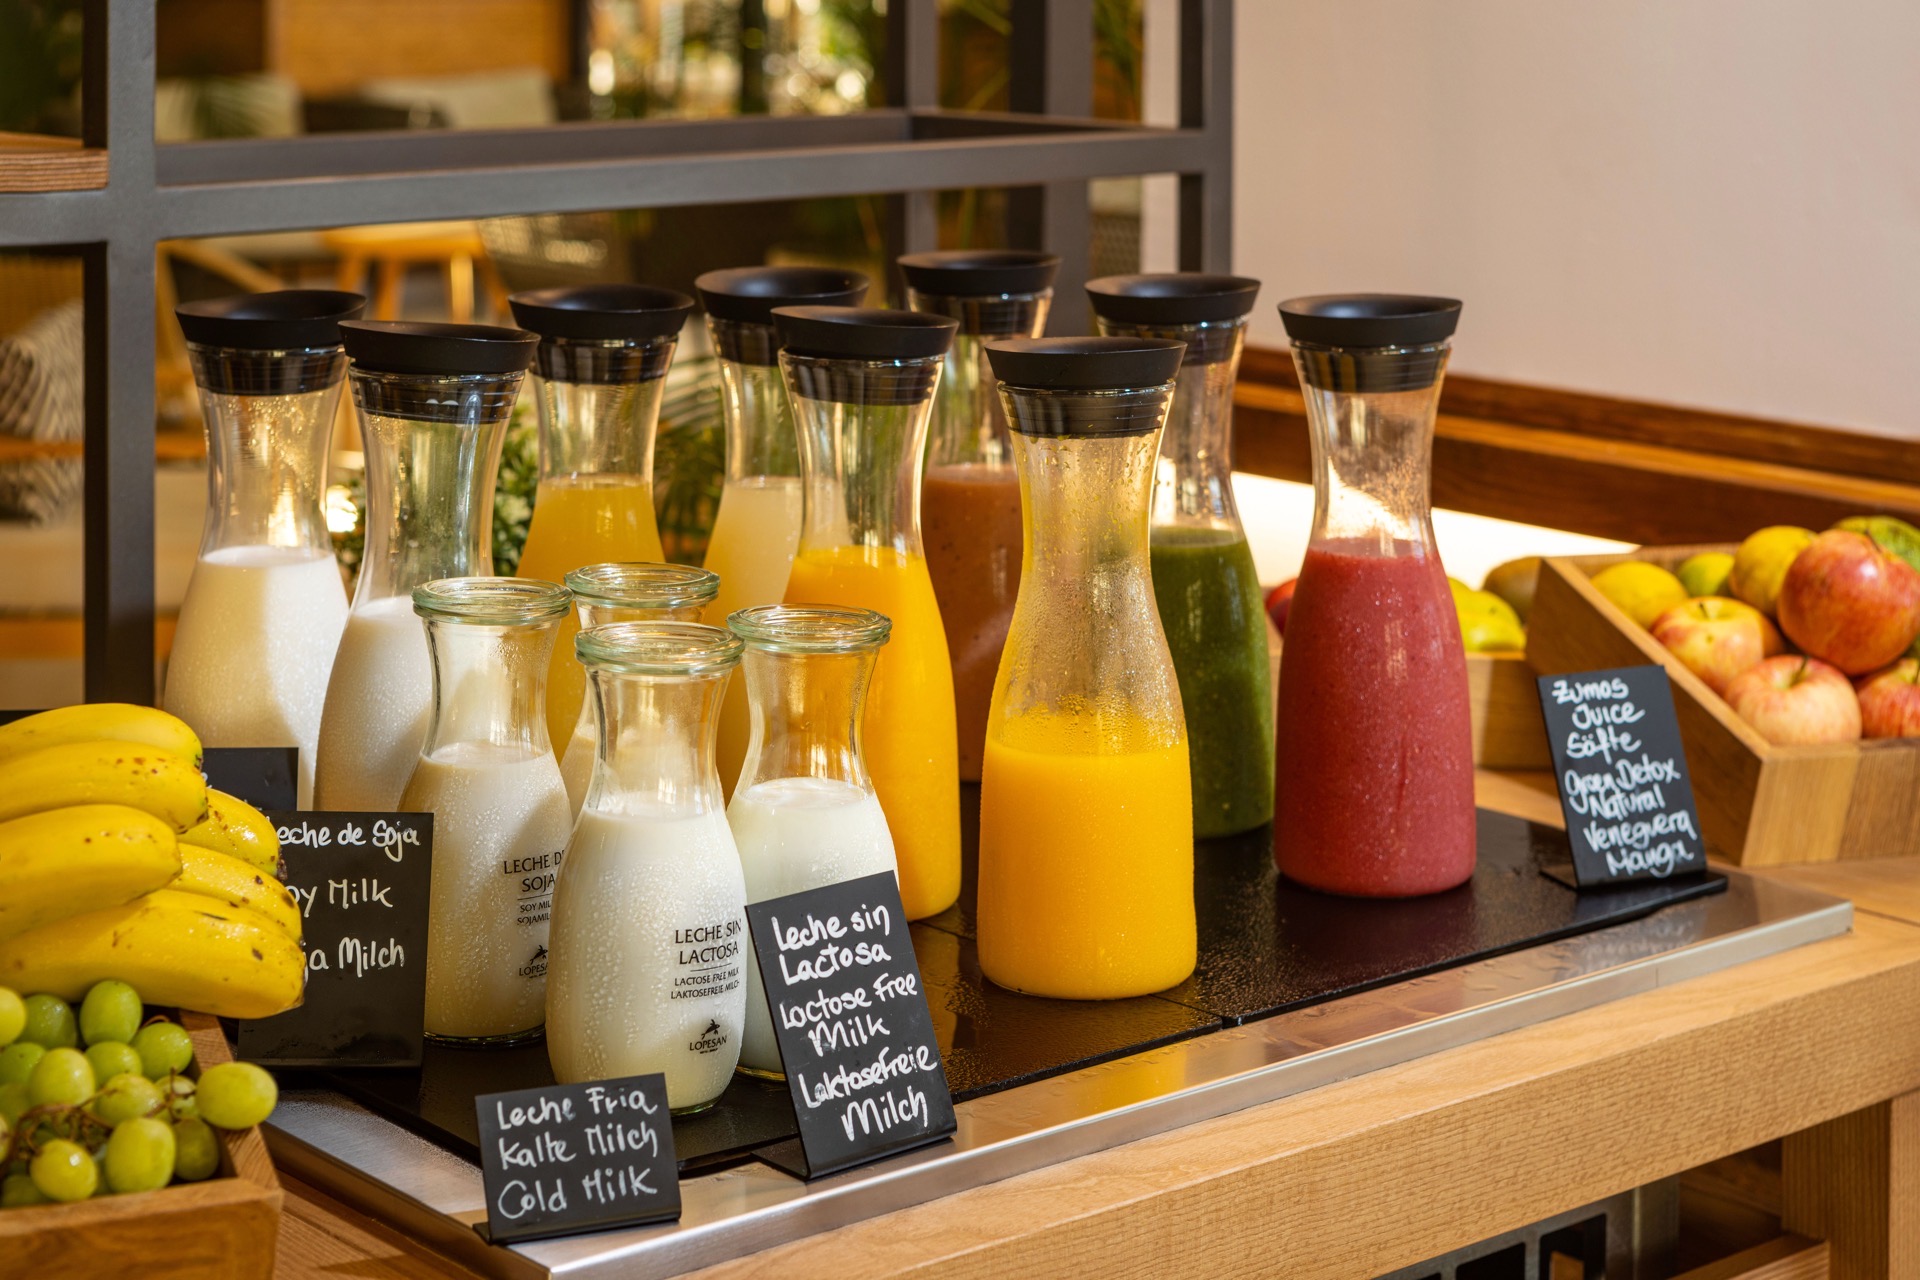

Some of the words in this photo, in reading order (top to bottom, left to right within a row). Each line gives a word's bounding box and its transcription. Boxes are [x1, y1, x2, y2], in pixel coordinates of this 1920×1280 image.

[1571, 701, 1646, 730] Juice
[266, 817, 332, 848] eche
[337, 822, 366, 846] de
[371, 819, 421, 862] Soja
[504, 855, 550, 874] LECHE
[554, 850, 565, 865] D
[284, 884, 318, 918] oy
[328, 877, 394, 909] Milk
[522, 874, 555, 892] SOJA
[520, 902, 538, 914] SOY
[539, 900, 551, 910] MIL
[675, 925, 722, 943] LECHE
[771, 914, 848, 951] Leche
[850, 904, 891, 936] sin
[338, 936, 405, 978] Milch
[679, 941, 738, 964] LACTOSA
[779, 942, 892, 986] Lactosa
[675, 976, 710, 986] LACTOSE
[712, 970, 727, 982] FREE
[690, 1035, 727, 1051] LOPESAN
[808, 1014, 891, 1057] Milk
[497, 1096, 576, 1130] Leche
[840, 1085, 928, 1142] Milch
[584, 1121, 658, 1158] Milch
[498, 1178, 567, 1219] Cold
